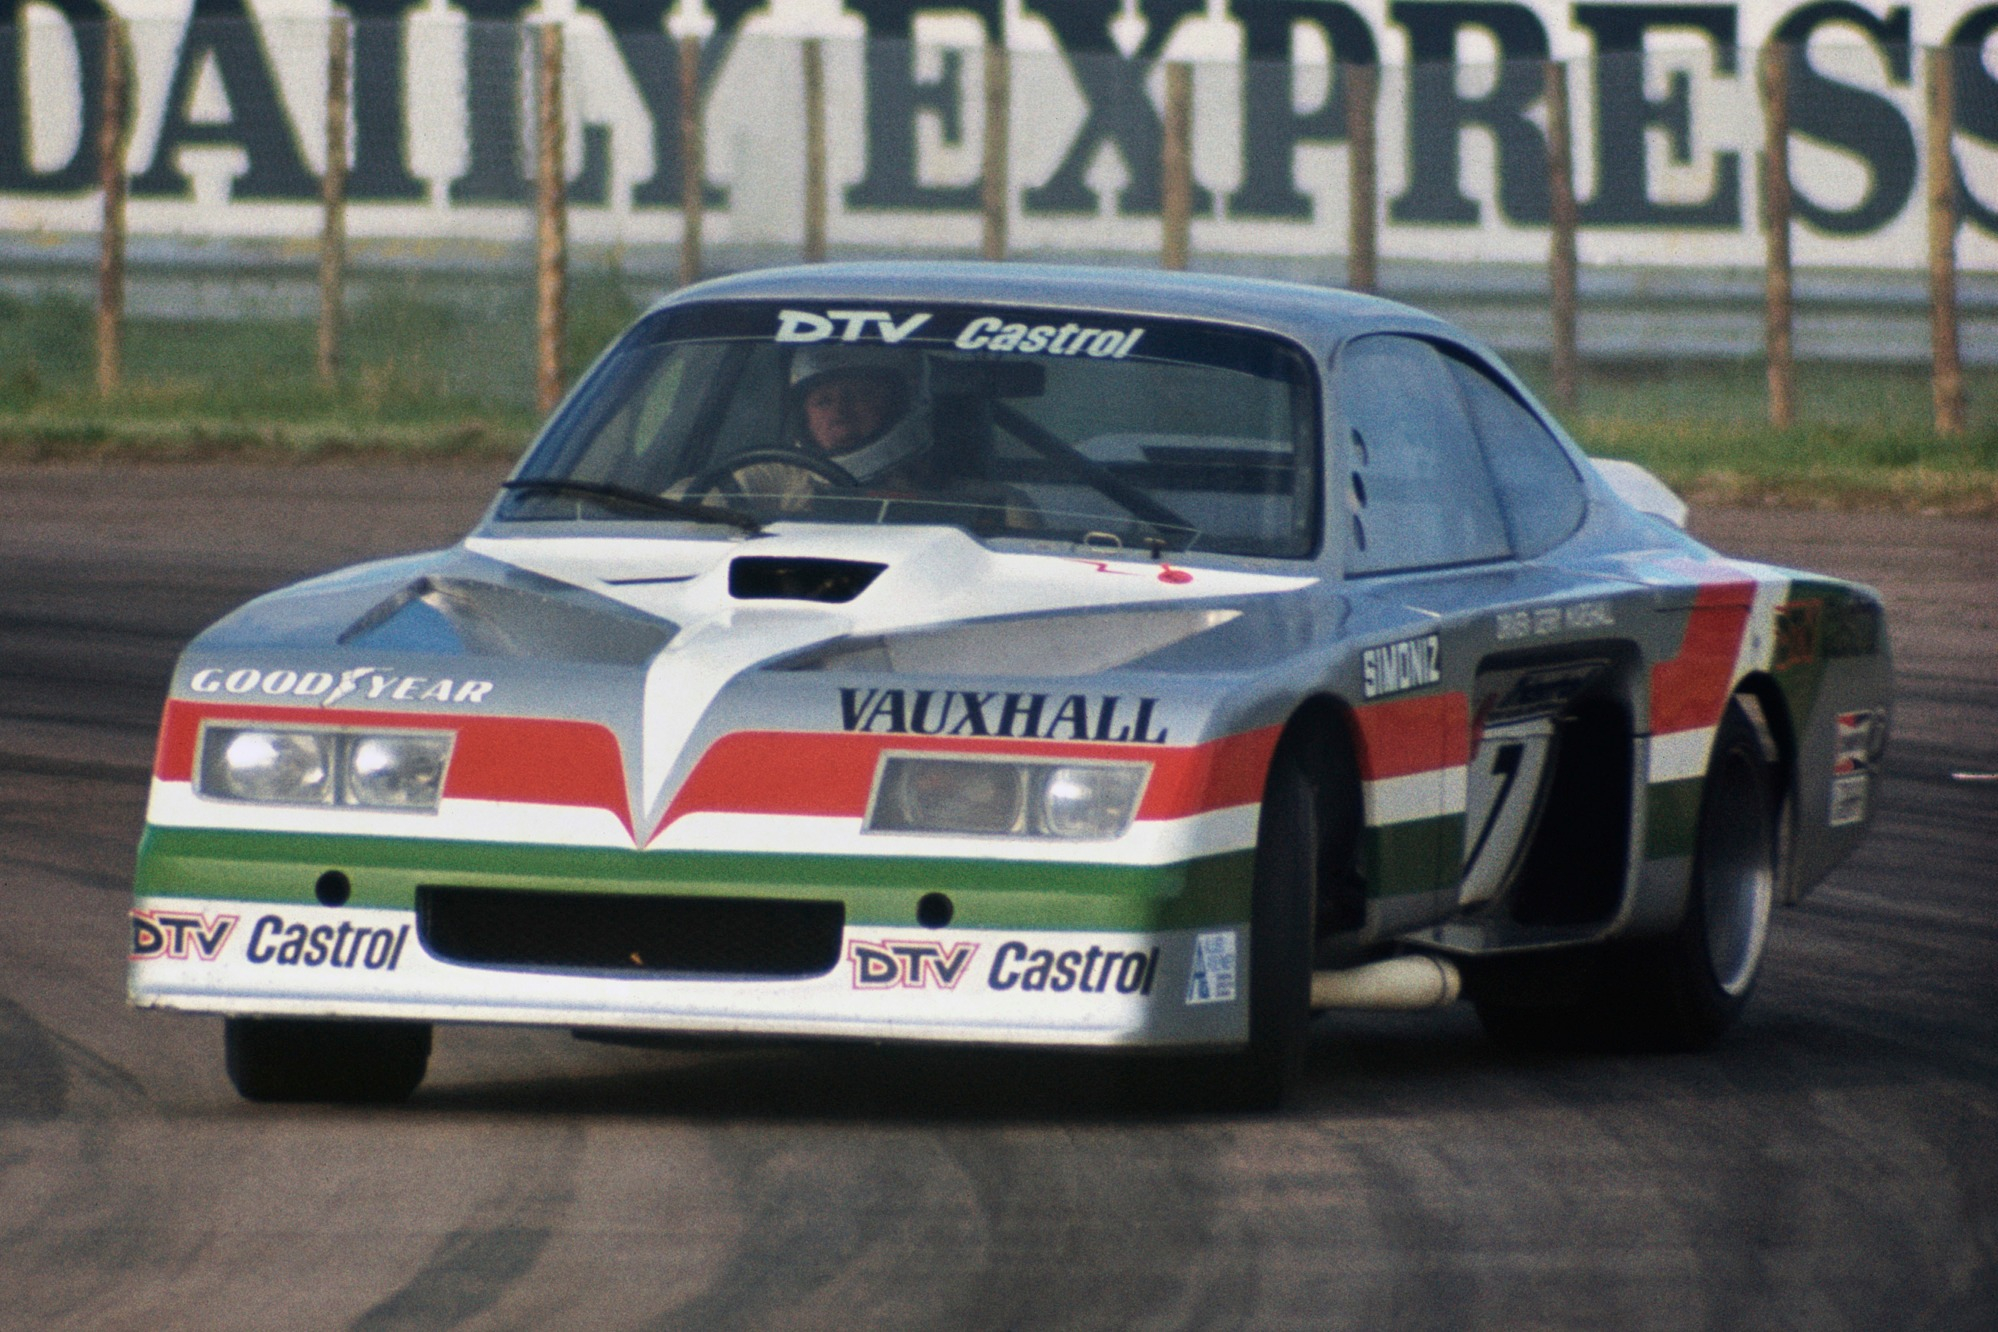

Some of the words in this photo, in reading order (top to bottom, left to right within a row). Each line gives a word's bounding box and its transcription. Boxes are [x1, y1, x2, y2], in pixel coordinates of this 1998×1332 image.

[0, 0, 770, 211] DAILY
[775, 310, 933, 342] DTV
[954, 316, 1146, 358] Castrol
[1363, 635, 1440, 697] SIMONIZ
[839, 687, 1168, 744] VAUXHALL
[1461, 743, 1524, 884] 7
[131, 911, 237, 959] DTV
[246, 914, 410, 971] Castrol
[849, 941, 977, 988] DTV
[988, 941, 1159, 996] Castrol
